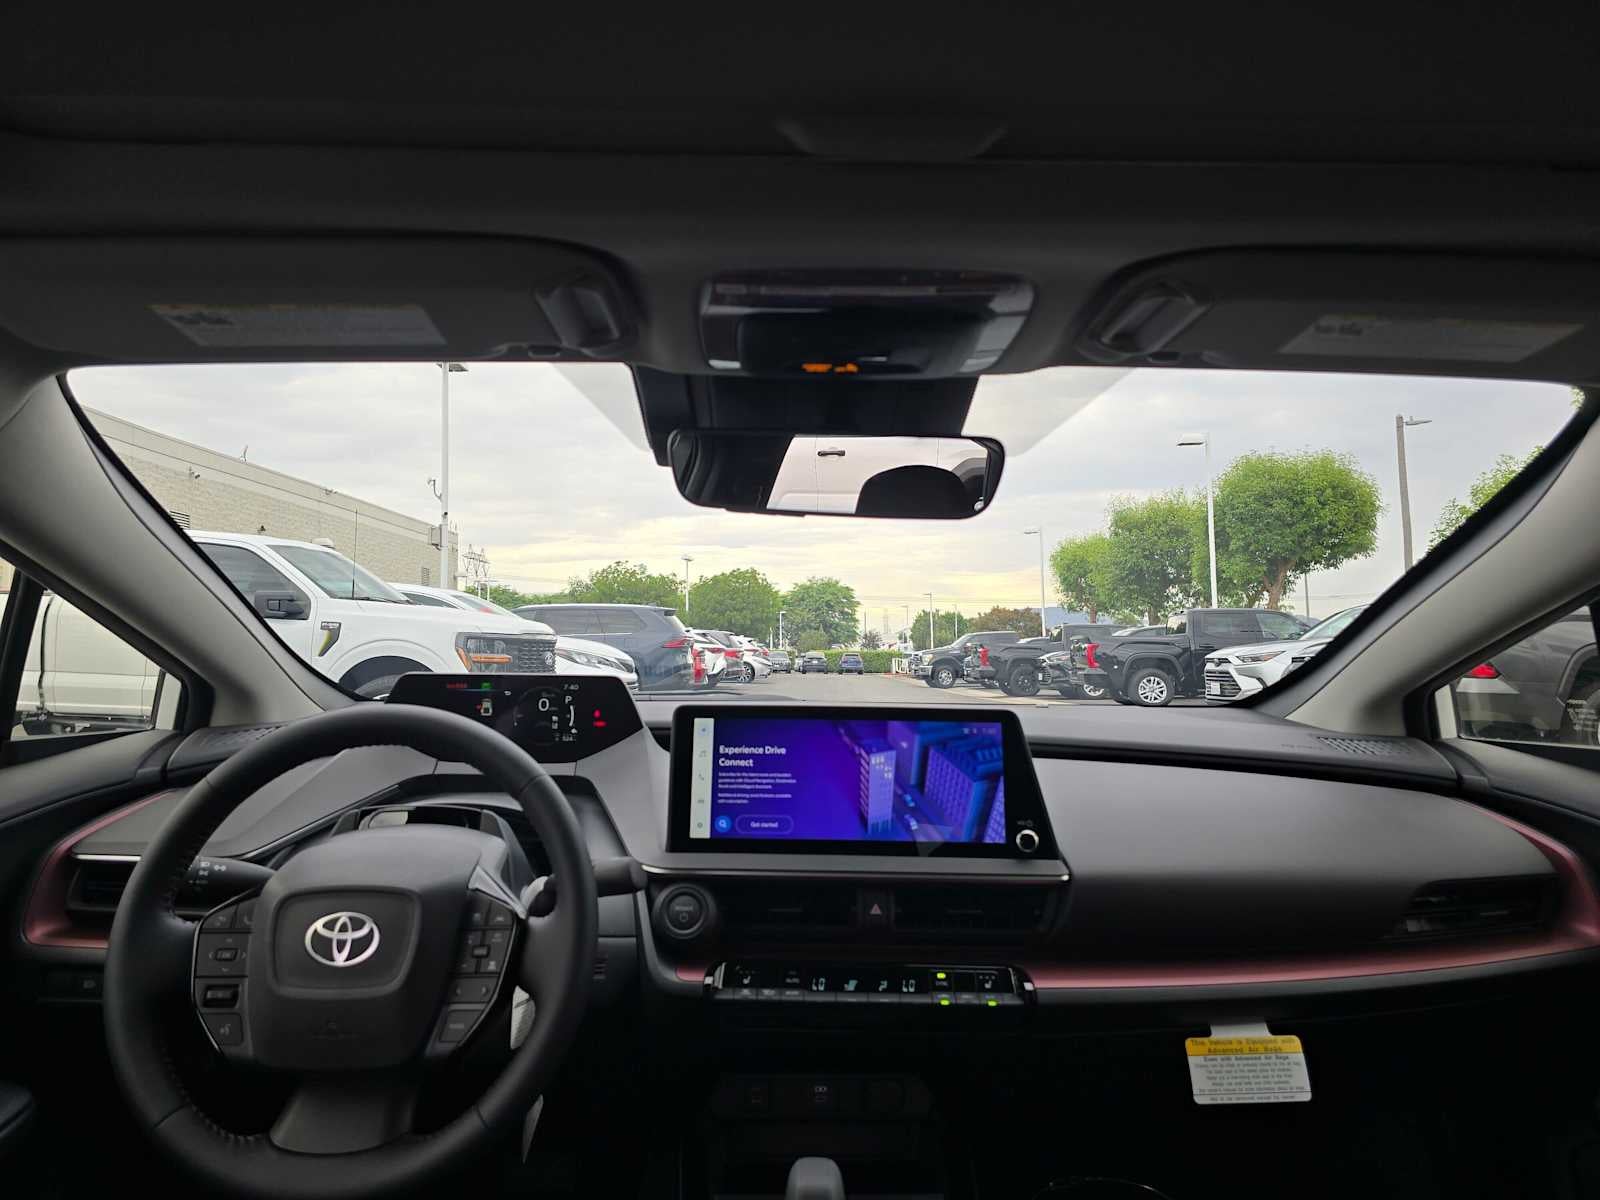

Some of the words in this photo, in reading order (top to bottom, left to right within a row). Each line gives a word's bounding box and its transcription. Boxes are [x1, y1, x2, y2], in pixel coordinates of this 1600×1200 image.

[538, 697, 550, 712] 0
[565, 695, 573, 705] P
[719, 745, 764, 755] Experience
[765, 746, 787, 755] Drive
[719, 758, 754, 767] Connect
